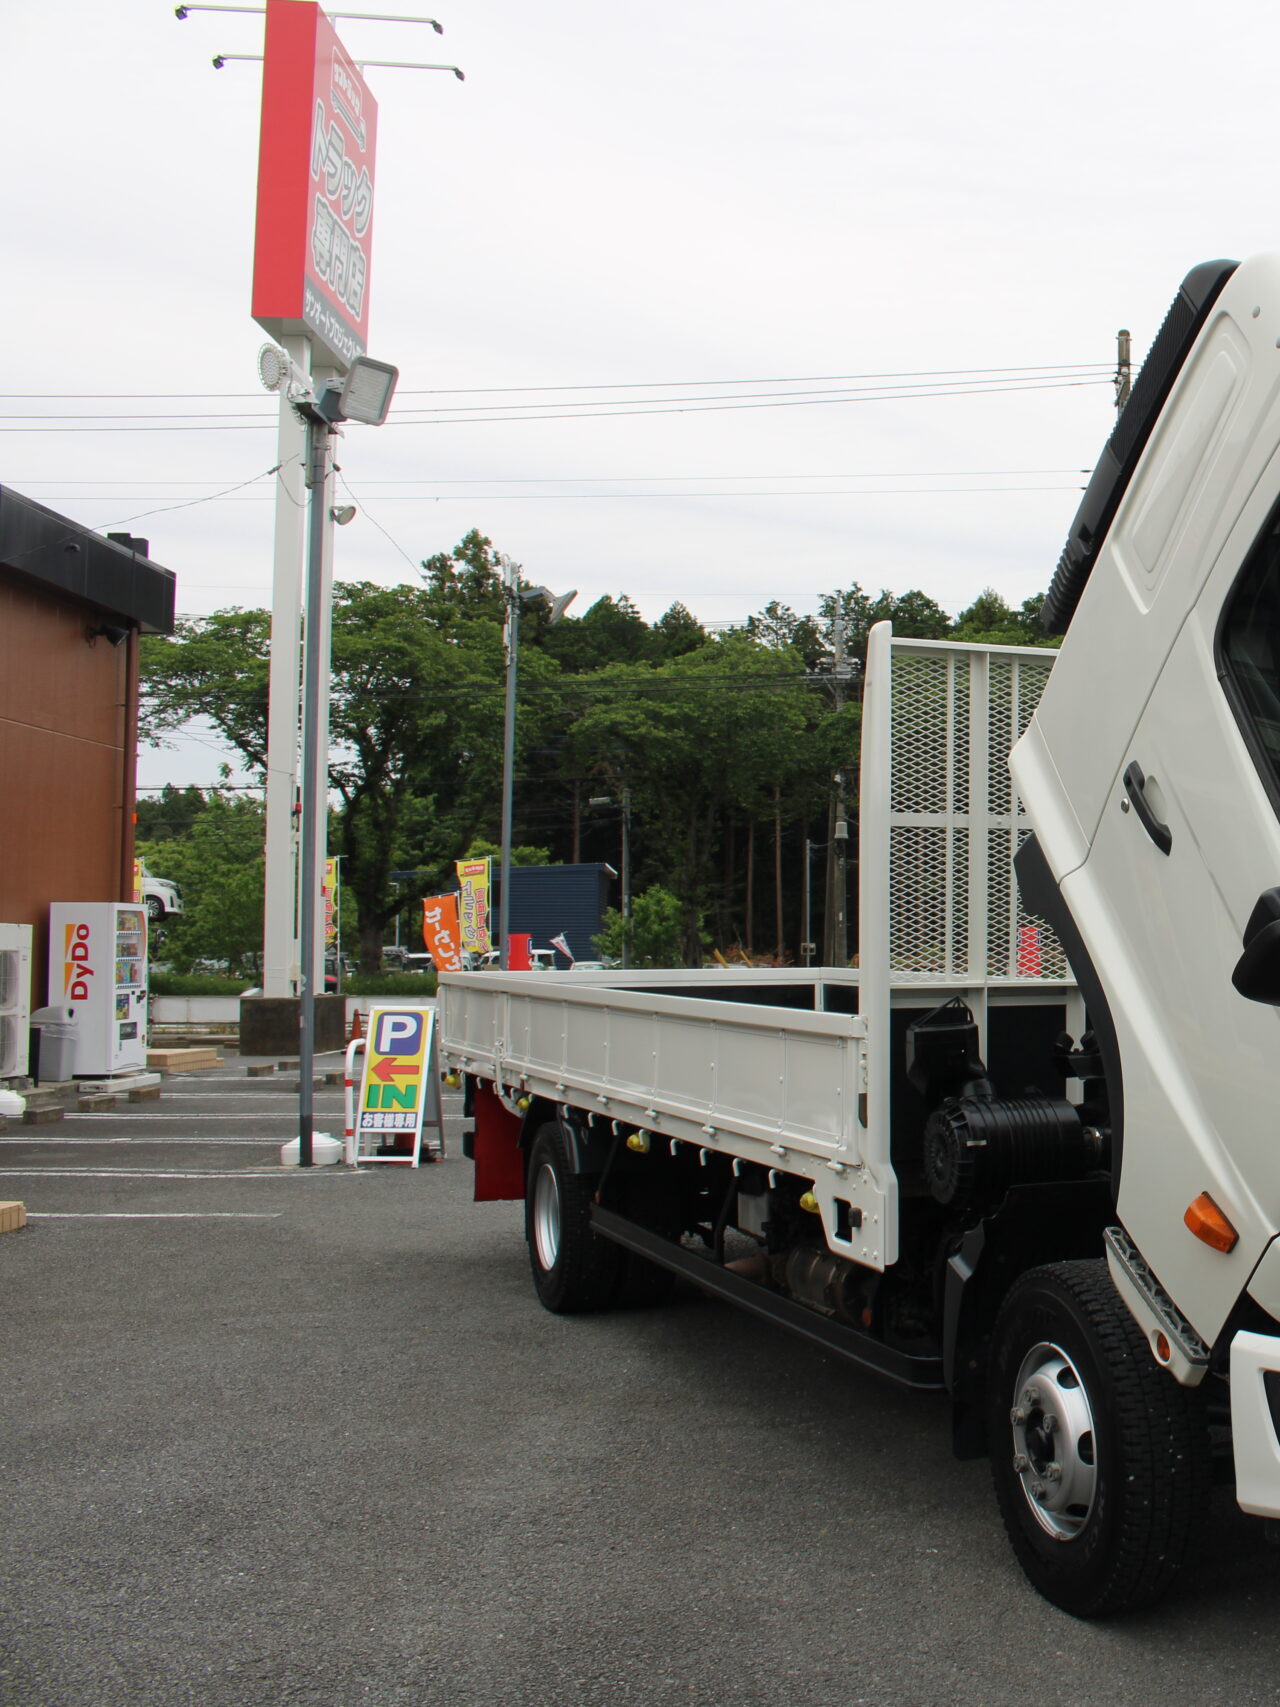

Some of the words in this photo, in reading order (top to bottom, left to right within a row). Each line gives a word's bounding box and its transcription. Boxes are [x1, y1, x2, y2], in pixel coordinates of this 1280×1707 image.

[310, 98, 373, 238] トラック
[311, 192, 367, 322] 専門店
[71, 923, 94, 1001] DyDo
[379, 1015, 418, 1053] P
[361, 1112, 417, 1128] お客様専用
[366, 1084, 418, 1109] IN
